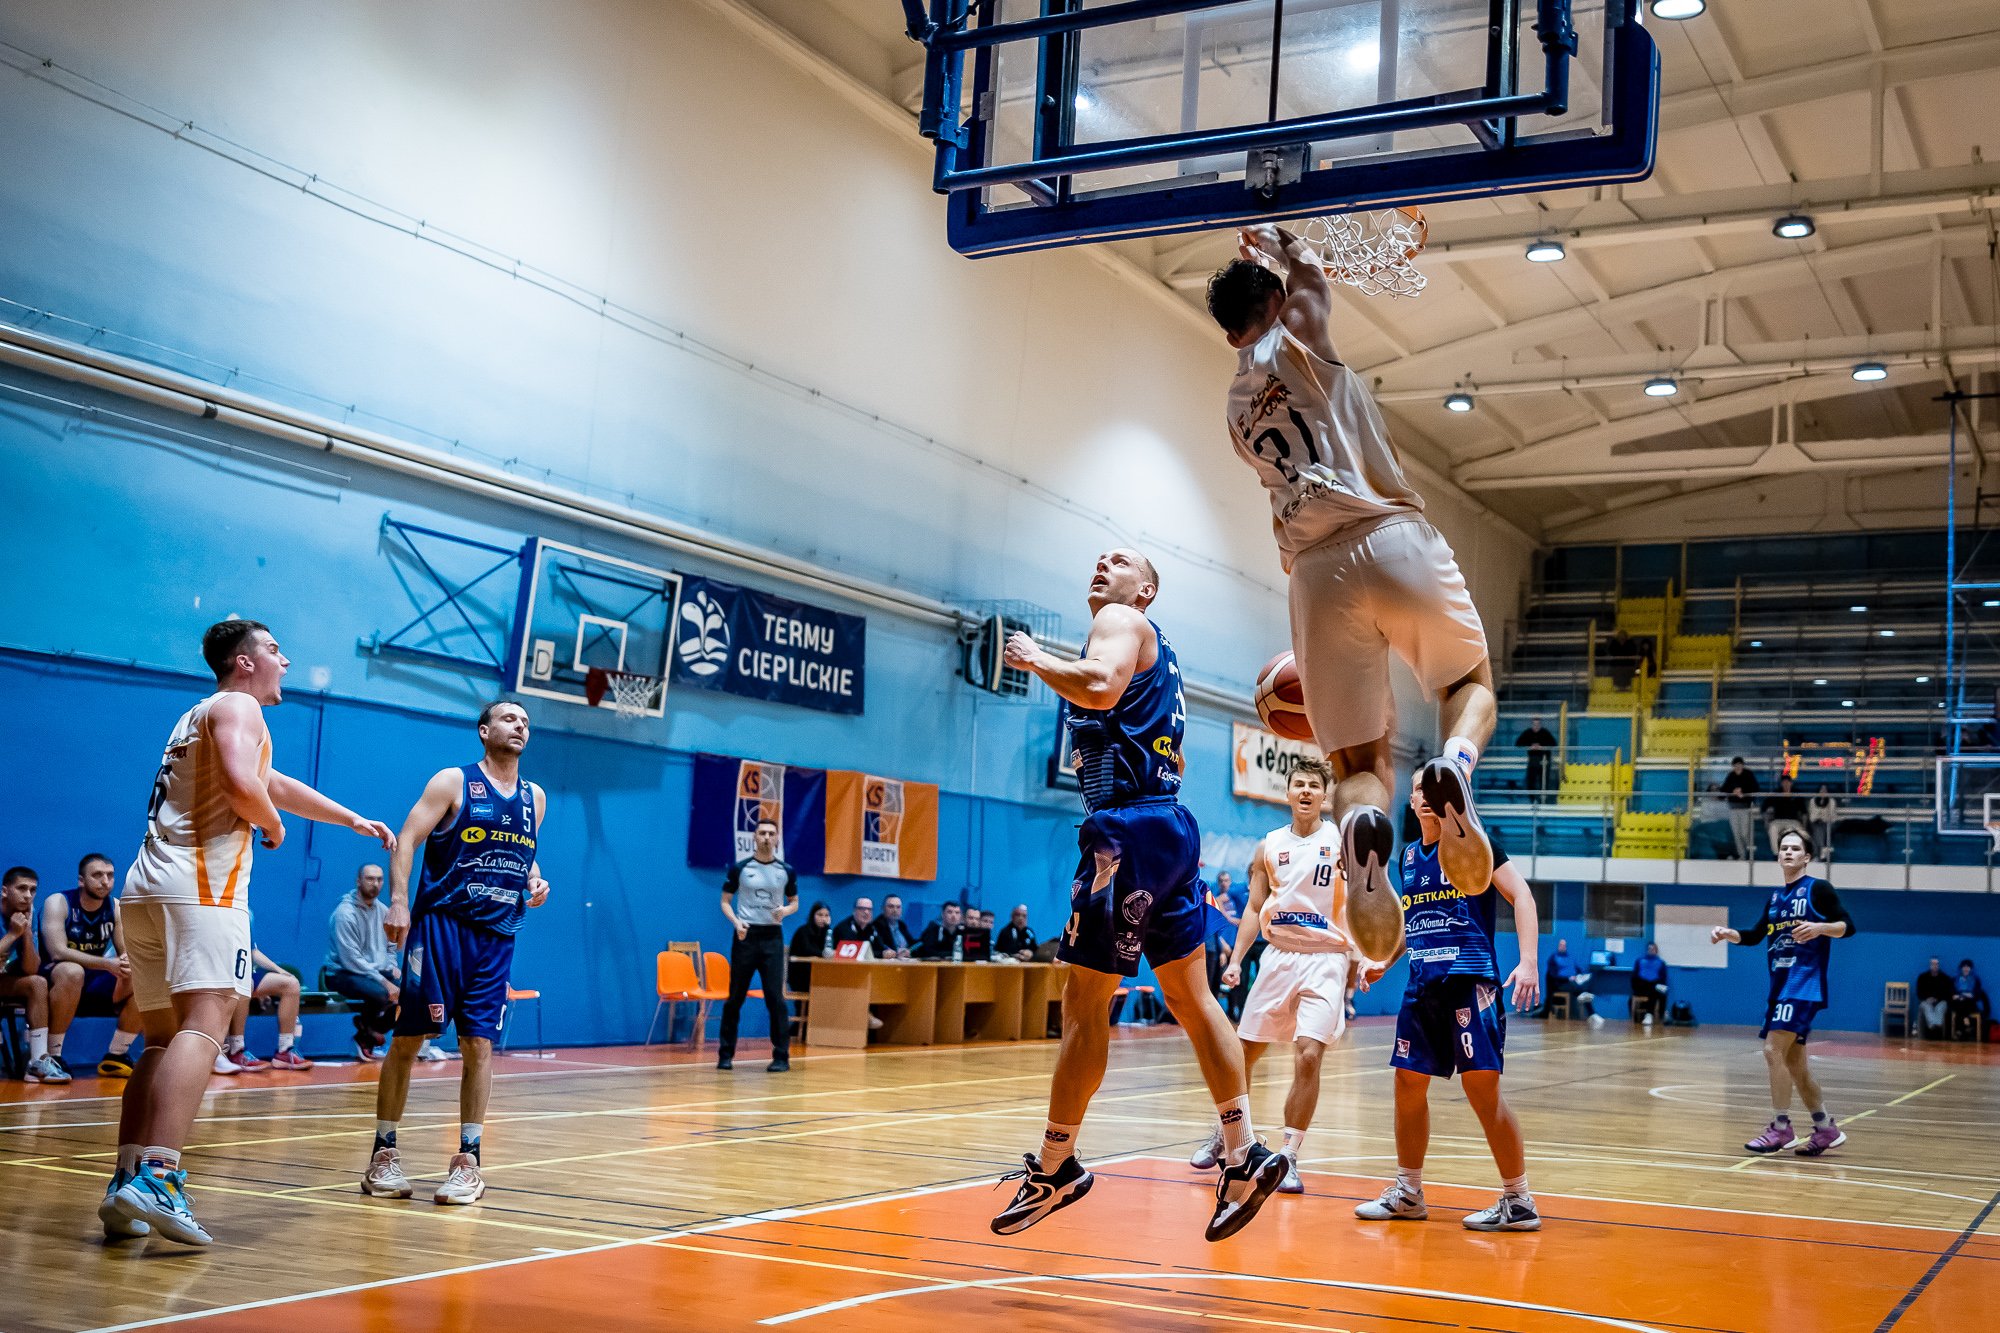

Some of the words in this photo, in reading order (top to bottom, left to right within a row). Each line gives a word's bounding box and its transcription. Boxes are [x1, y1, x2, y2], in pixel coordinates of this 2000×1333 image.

[1253, 405, 1320, 484] 21
[763, 612, 835, 655] TERMY
[738, 647, 854, 696] CIEPLICKIE
[522, 805, 532, 833] 5
[467, 829, 480, 840] K
[490, 830, 536, 850] ZETKAMA
[1312, 863, 1332, 887] 19
[1413, 889, 1466, 905] ZETKAMA
[1789, 898, 1807, 917] 30
[234, 948, 248, 980] 6
[1771, 1003, 1794, 1023] 30
[1461, 1031, 1474, 1059] 8
